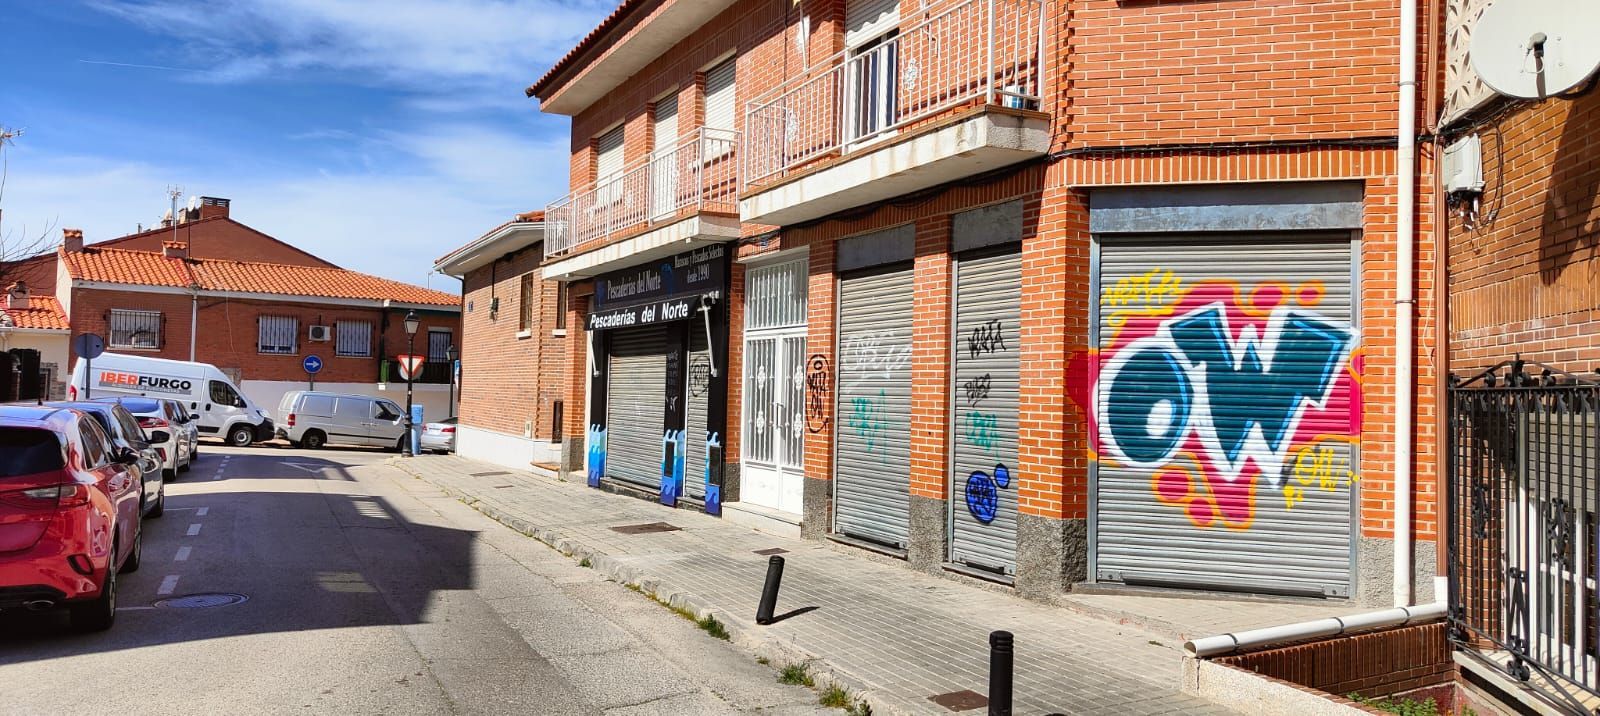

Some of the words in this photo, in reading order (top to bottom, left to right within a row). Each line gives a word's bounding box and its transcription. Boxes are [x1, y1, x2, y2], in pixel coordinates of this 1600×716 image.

[636, 273, 645, 294] del
[645, 270, 661, 291] Norte
[698, 263, 710, 281] 1990
[590, 309, 636, 329] Pescaderías
[641, 306, 656, 322] del
[661, 301, 689, 320] Norte
[100, 372, 191, 390] IBERFURGO
